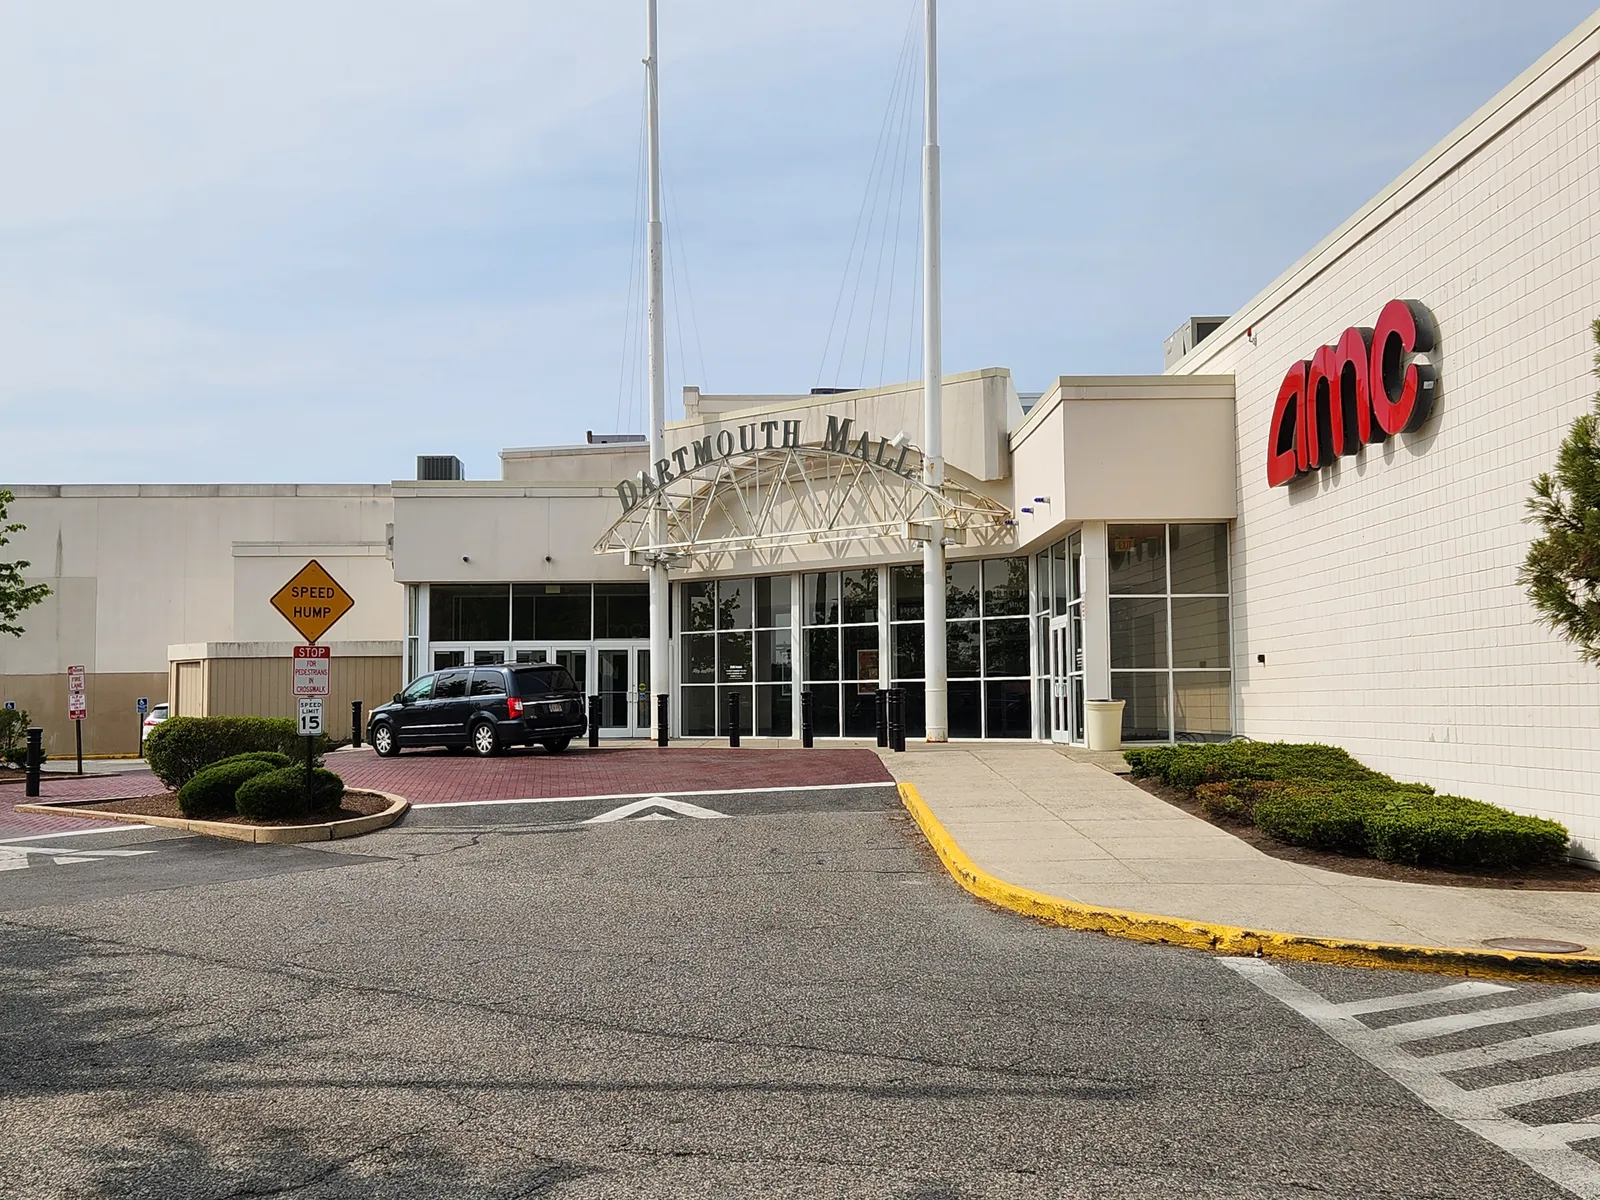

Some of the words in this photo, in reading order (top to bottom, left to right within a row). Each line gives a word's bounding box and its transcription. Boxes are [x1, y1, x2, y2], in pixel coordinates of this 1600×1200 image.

[614, 419, 803, 515] DARTMOUTH
[820, 414, 913, 479] MALL
[291, 586, 335, 599] SPEED
[293, 606, 332, 619] HUMP
[298, 647, 326, 658] STOP
[295, 668, 328, 676] PEDESTRIANS
[296, 685, 326, 693] CROSSWALK
[301, 715, 320, 730] 15
